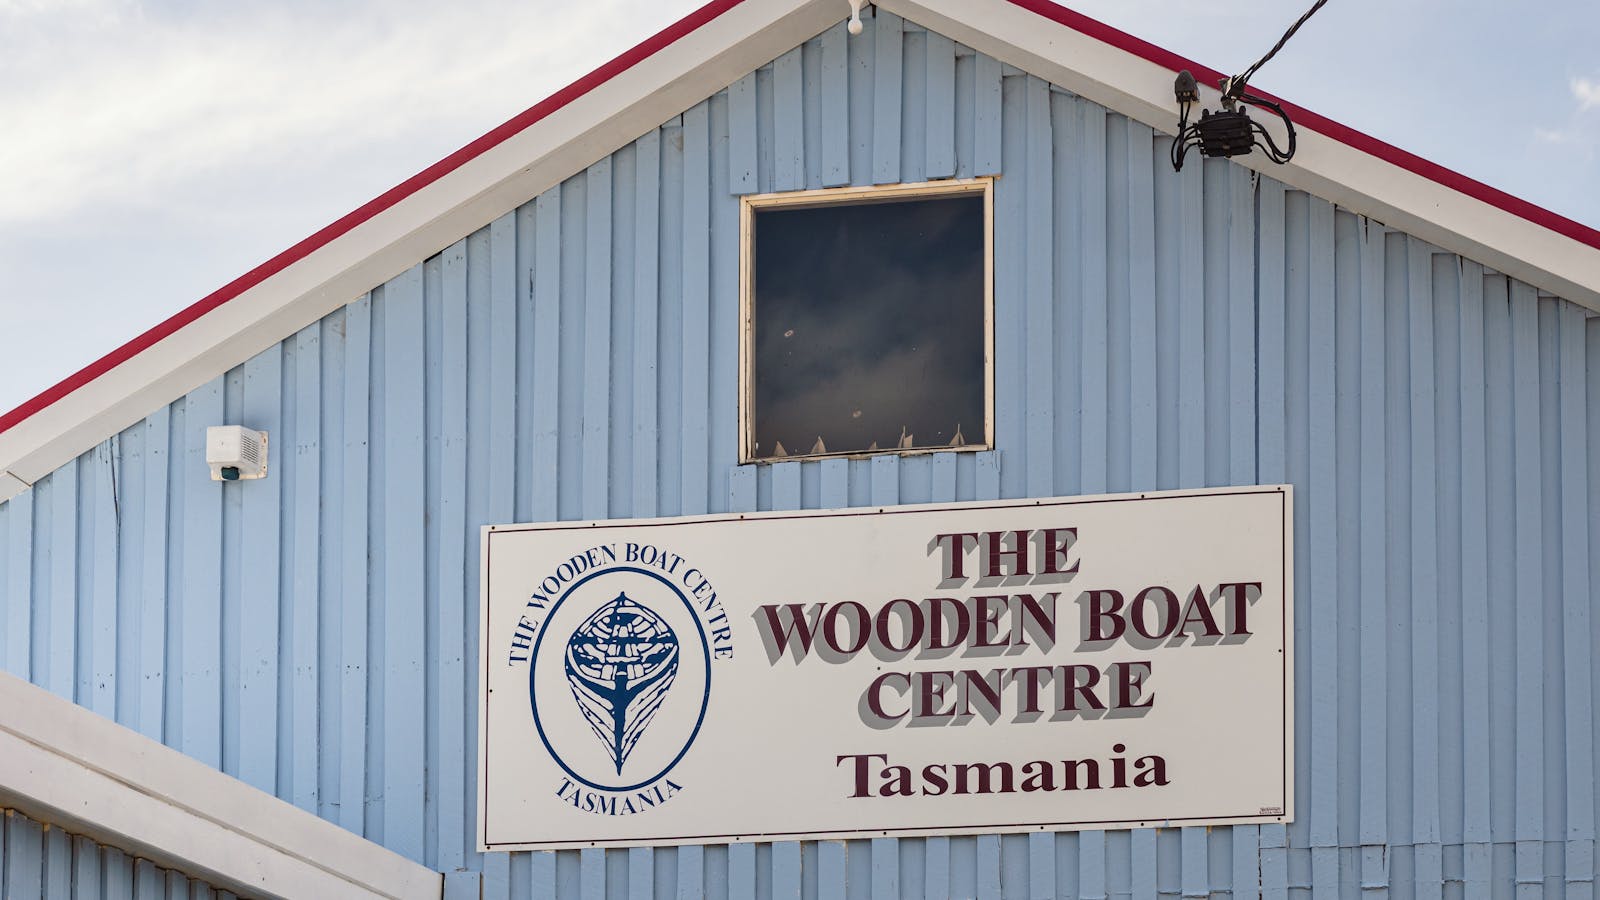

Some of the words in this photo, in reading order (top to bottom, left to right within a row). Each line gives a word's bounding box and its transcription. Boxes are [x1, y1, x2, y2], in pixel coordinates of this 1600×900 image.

[936, 527, 1081, 579] THE
[508, 615, 538, 667] THE
[527, 543, 617, 611] WOODEN
[625, 542, 685, 575] BOAT
[683, 568, 734, 660] CENTRE
[760, 592, 1062, 654] WOODEN
[1080, 581, 1262, 642] BOAT
[867, 661, 1155, 720] CENTRE
[555, 777, 683, 816] TASMANIA
[836, 743, 1172, 799] Tasmania
